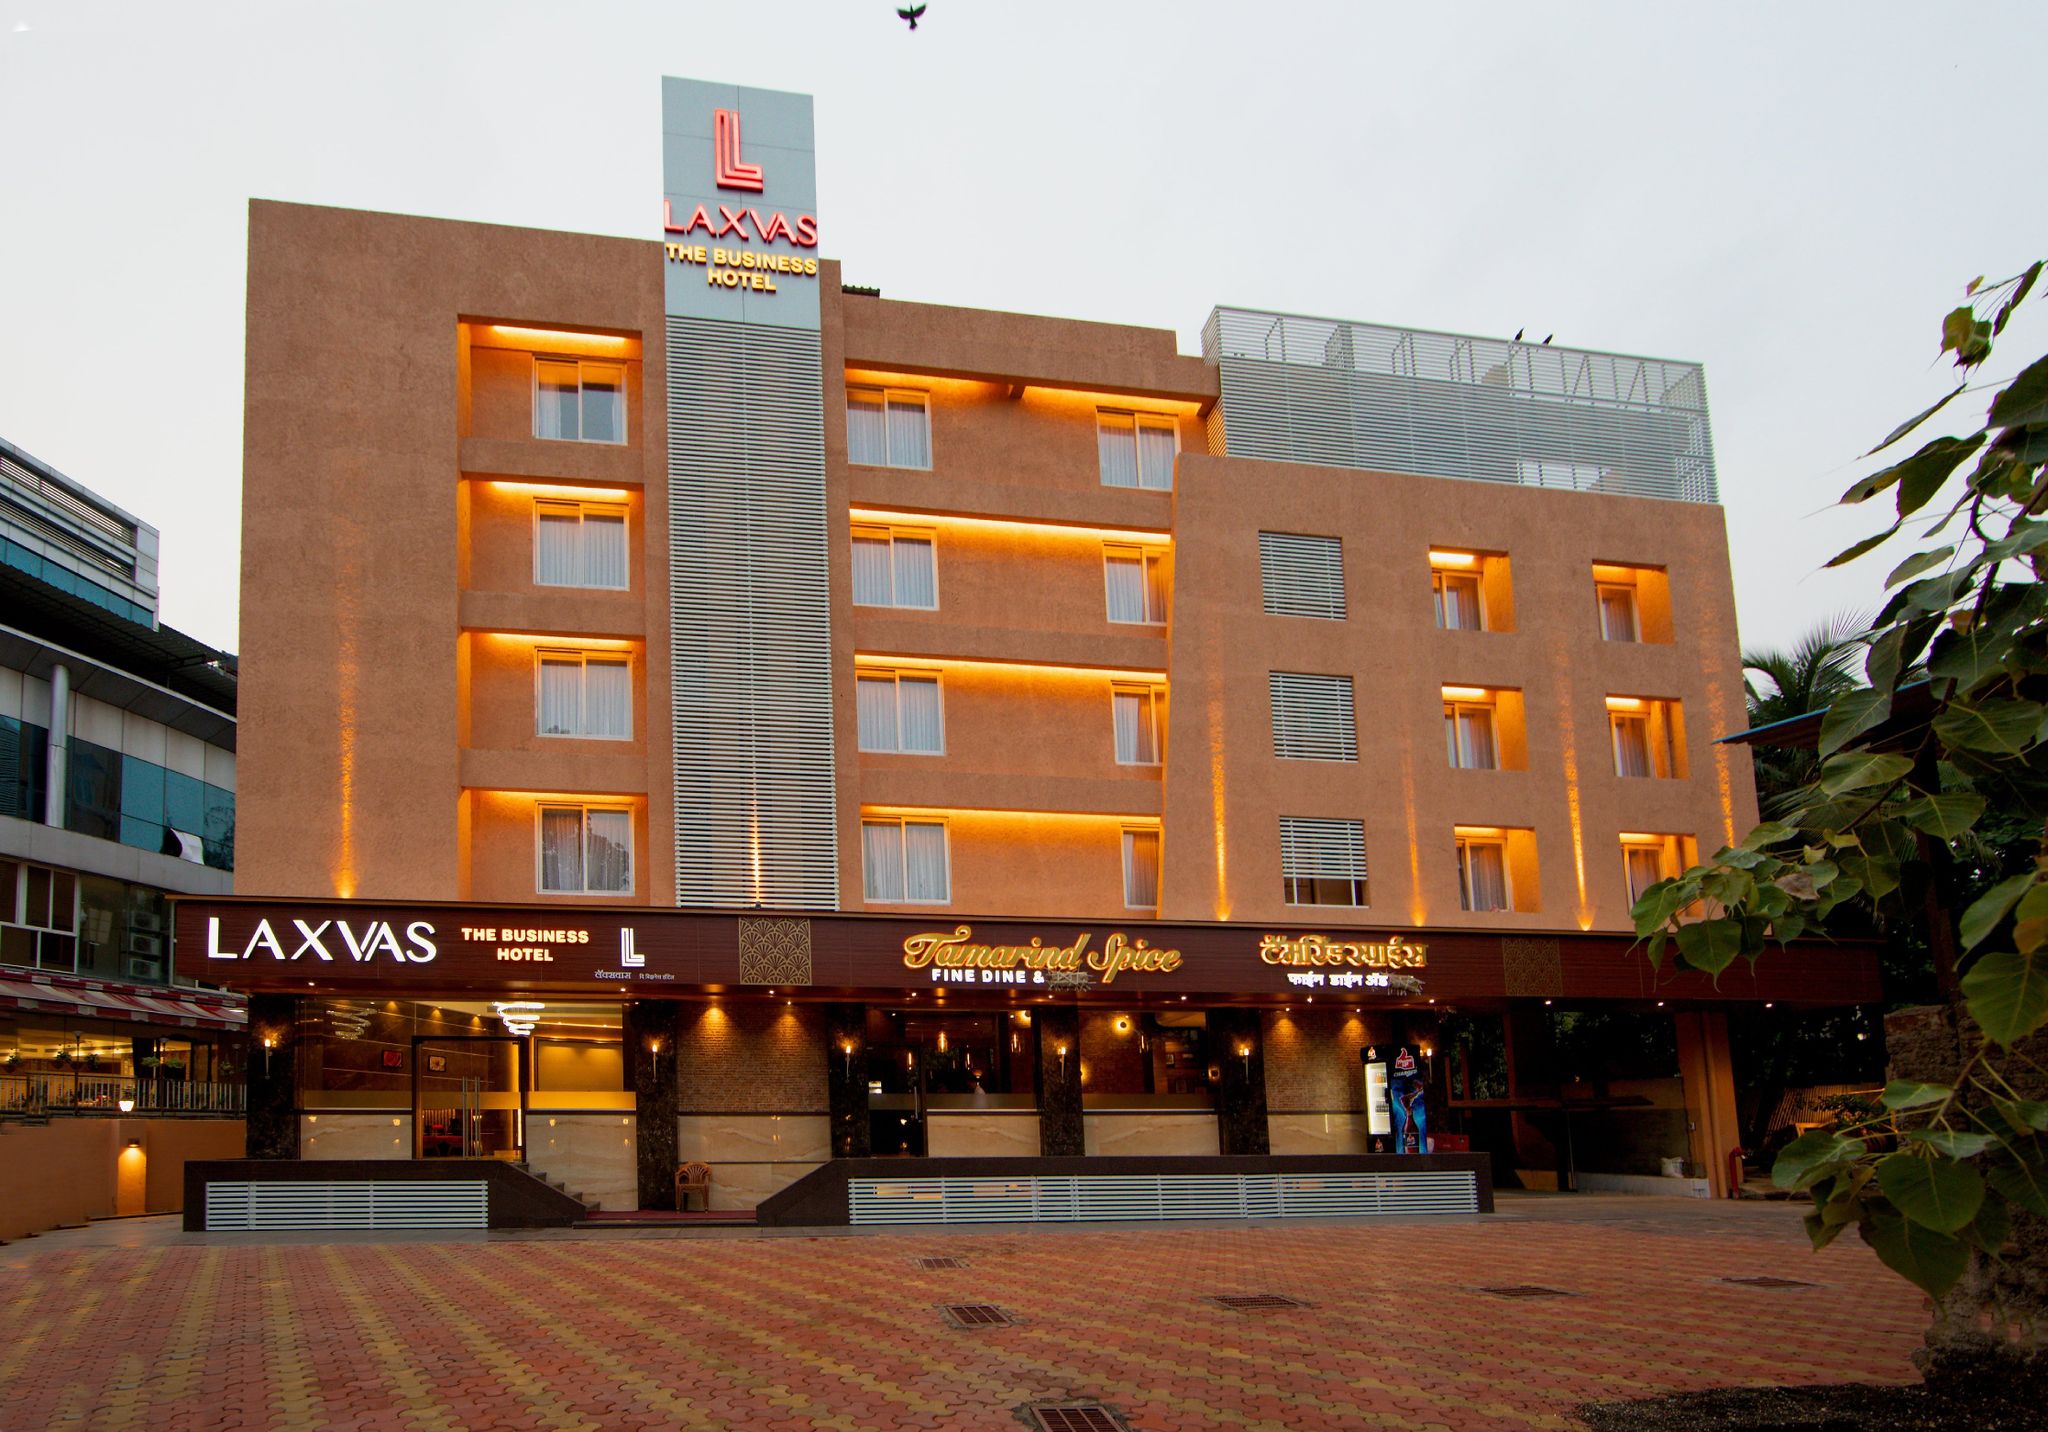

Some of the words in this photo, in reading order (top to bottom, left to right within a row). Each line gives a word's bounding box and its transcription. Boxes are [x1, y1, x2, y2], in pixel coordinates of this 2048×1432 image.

[664, 198, 818, 248] LAXVAS
[665, 243, 707, 265] THE
[713, 247, 817, 275] BUSINESS
[707, 268, 777, 294] HOTEL
[208, 916, 437, 963] LAXVAS
[461, 927, 497, 943] THE
[502, 928, 590, 945] BUSINESS
[497, 948, 554, 962] HOTEL
[904, 924, 1091, 970] Tamarind
[1087, 932, 1184, 983] Spice
[931, 968, 976, 983] FINE
[982, 969, 1027, 984] DINE
[1032, 970, 1045, 984] &
